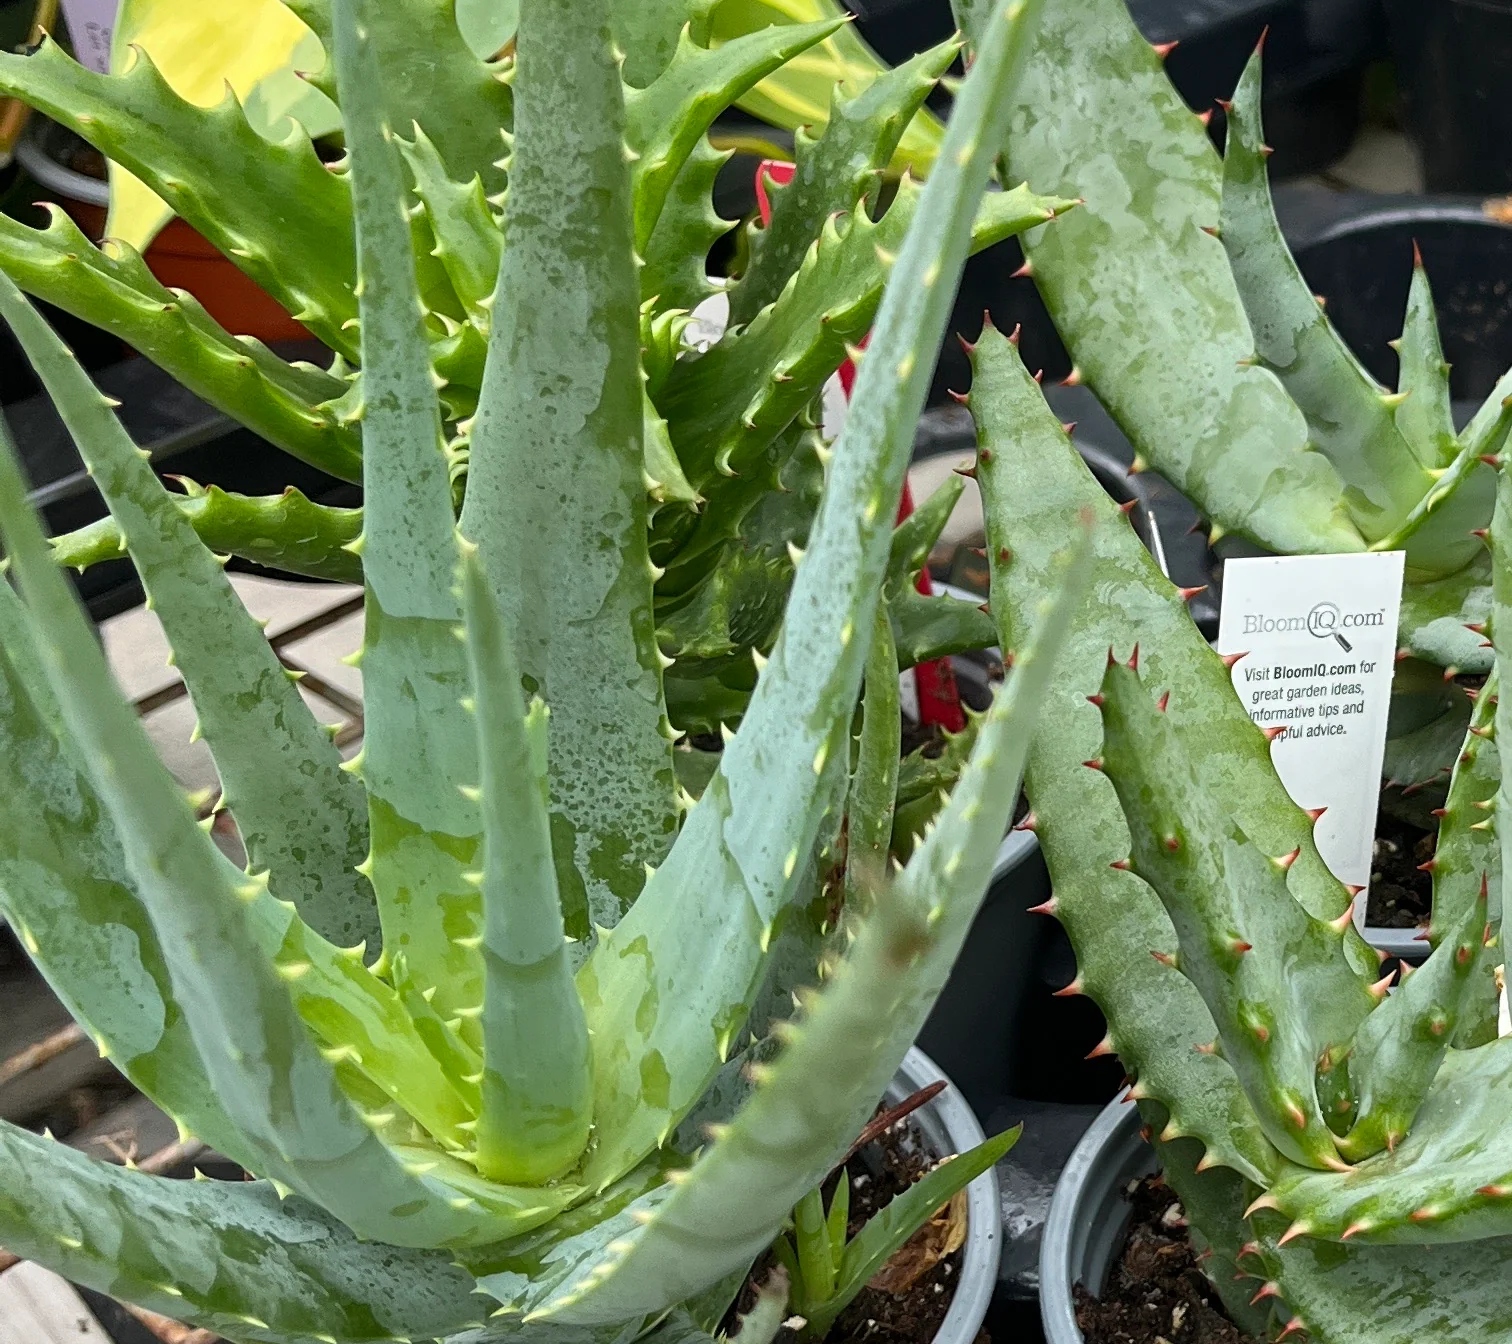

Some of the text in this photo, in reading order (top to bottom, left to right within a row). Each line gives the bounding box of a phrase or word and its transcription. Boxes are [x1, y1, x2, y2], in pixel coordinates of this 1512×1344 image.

[1243, 609, 1384, 634] BloomIQ.com
[1245, 660, 1377, 682] Visit BloomIQ.com for
[1252, 683, 1364, 704] great garden ideas,
[1249, 700, 1365, 722] informative tips and
[1307, 724, 1347, 738] advice.
